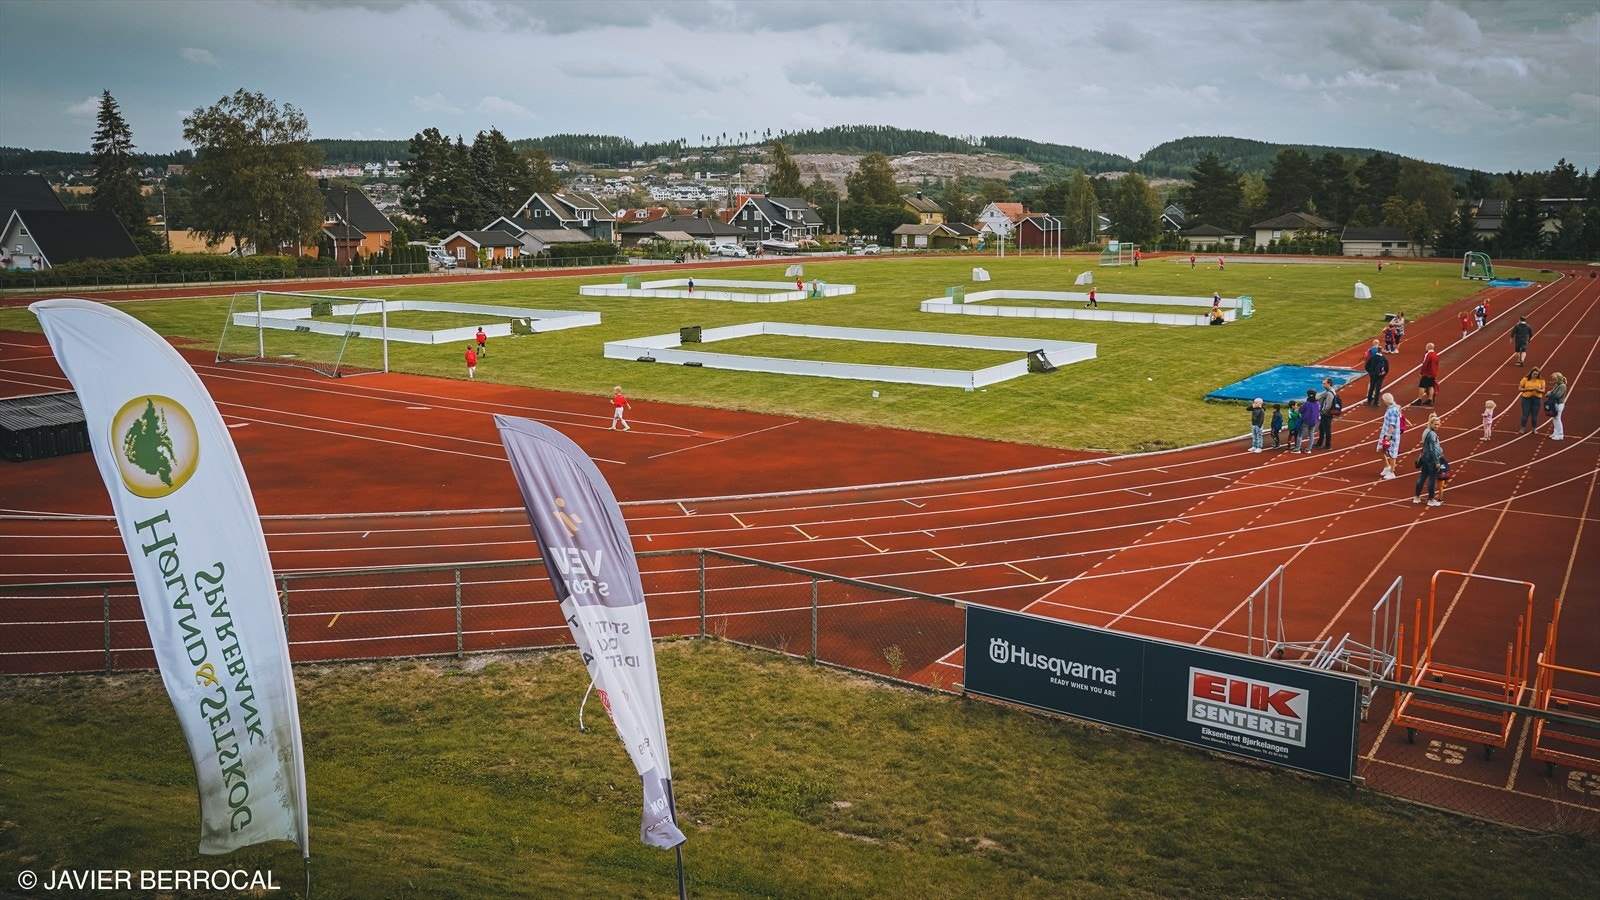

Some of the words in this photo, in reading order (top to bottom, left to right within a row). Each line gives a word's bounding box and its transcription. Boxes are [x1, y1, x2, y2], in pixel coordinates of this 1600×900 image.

[1011, 644, 1117, 685] Husqvarna
[1050, 676, 1070, 687] READY
[1071, 681, 1089, 691] WHEN
[1090, 686, 1103, 694] YOU
[1103, 689, 1117, 698] ARE
[1193, 671, 1302, 720] EIK
[1194, 703, 1299, 739] SENTERET
[1201, 727, 1241, 743] Eiksenteret
[1242, 736, 1289, 754] Bjørkelangen
